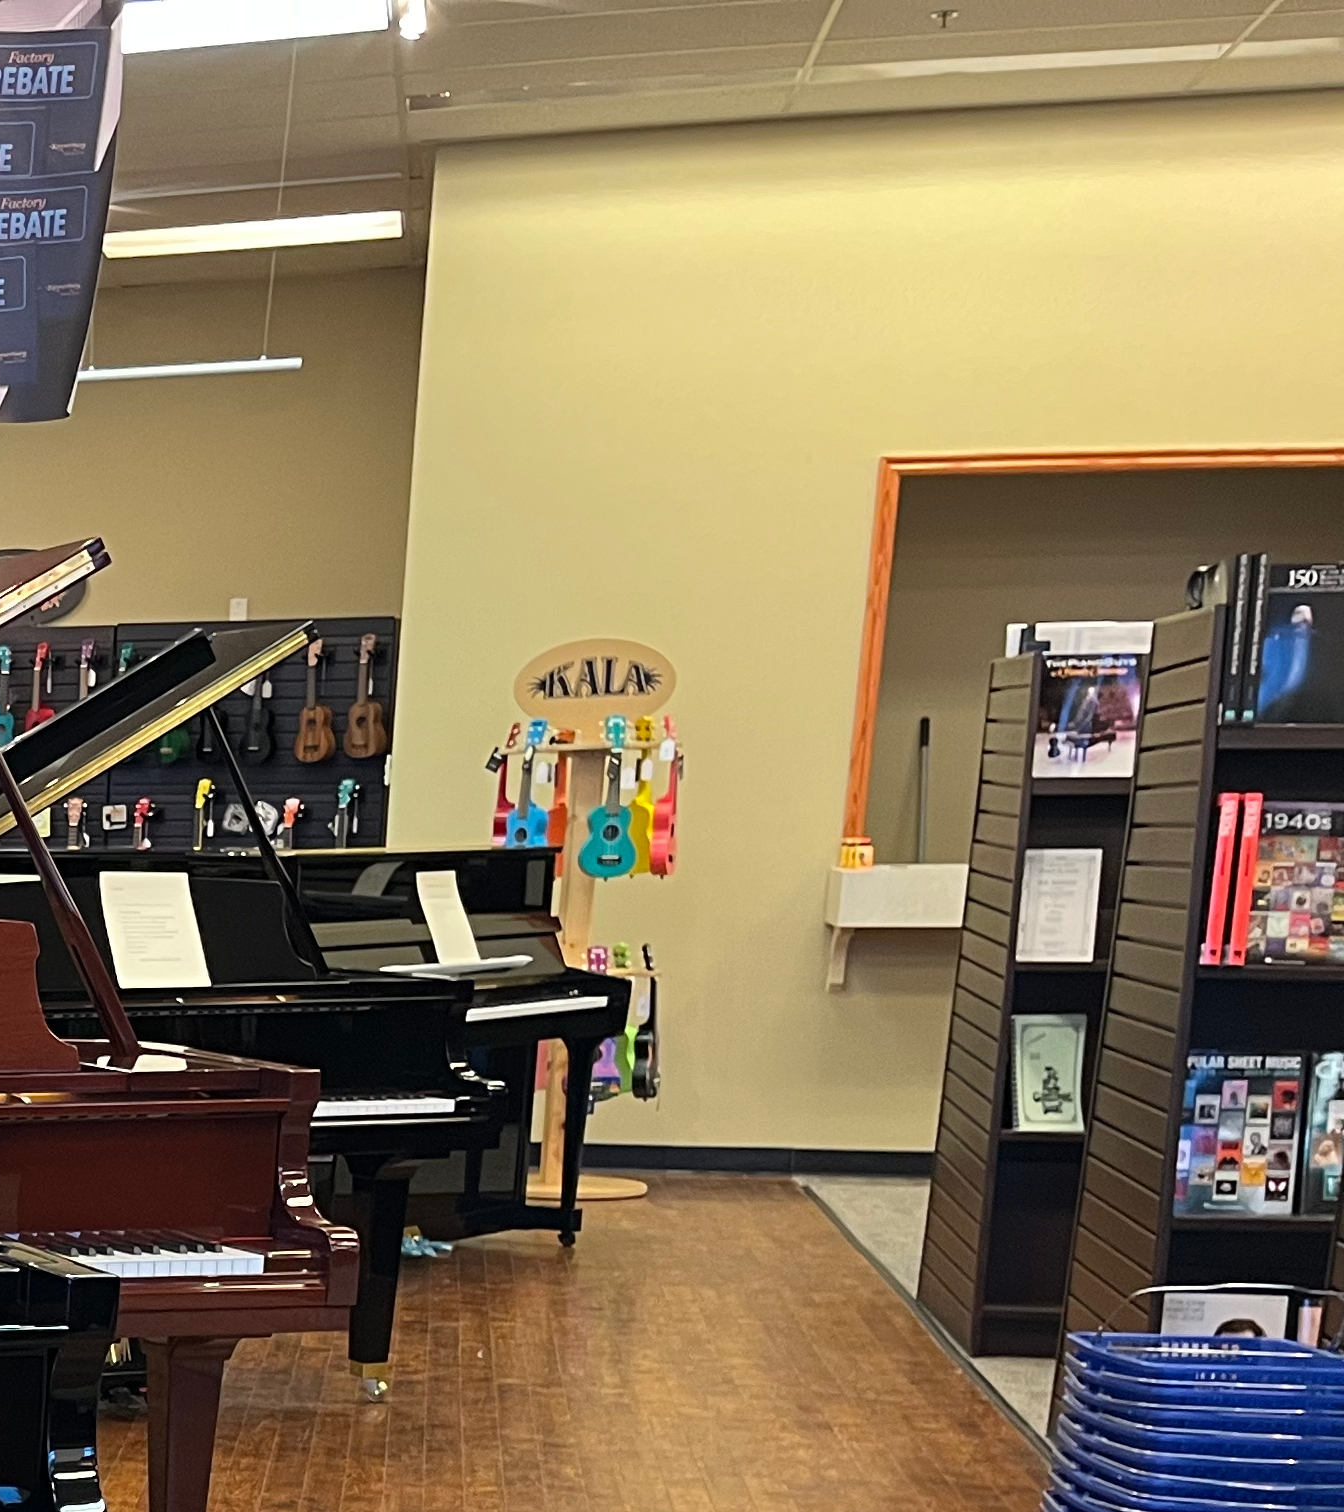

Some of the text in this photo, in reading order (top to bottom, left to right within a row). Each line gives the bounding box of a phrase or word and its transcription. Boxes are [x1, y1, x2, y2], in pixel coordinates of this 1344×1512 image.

[7, 50, 55, 65] Factory
[0, 196, 47, 211] Factory
[1288, 569, 1318, 588] 150
[541, 655, 650, 700] KALA
[1264, 813, 1332, 831] 1940s
